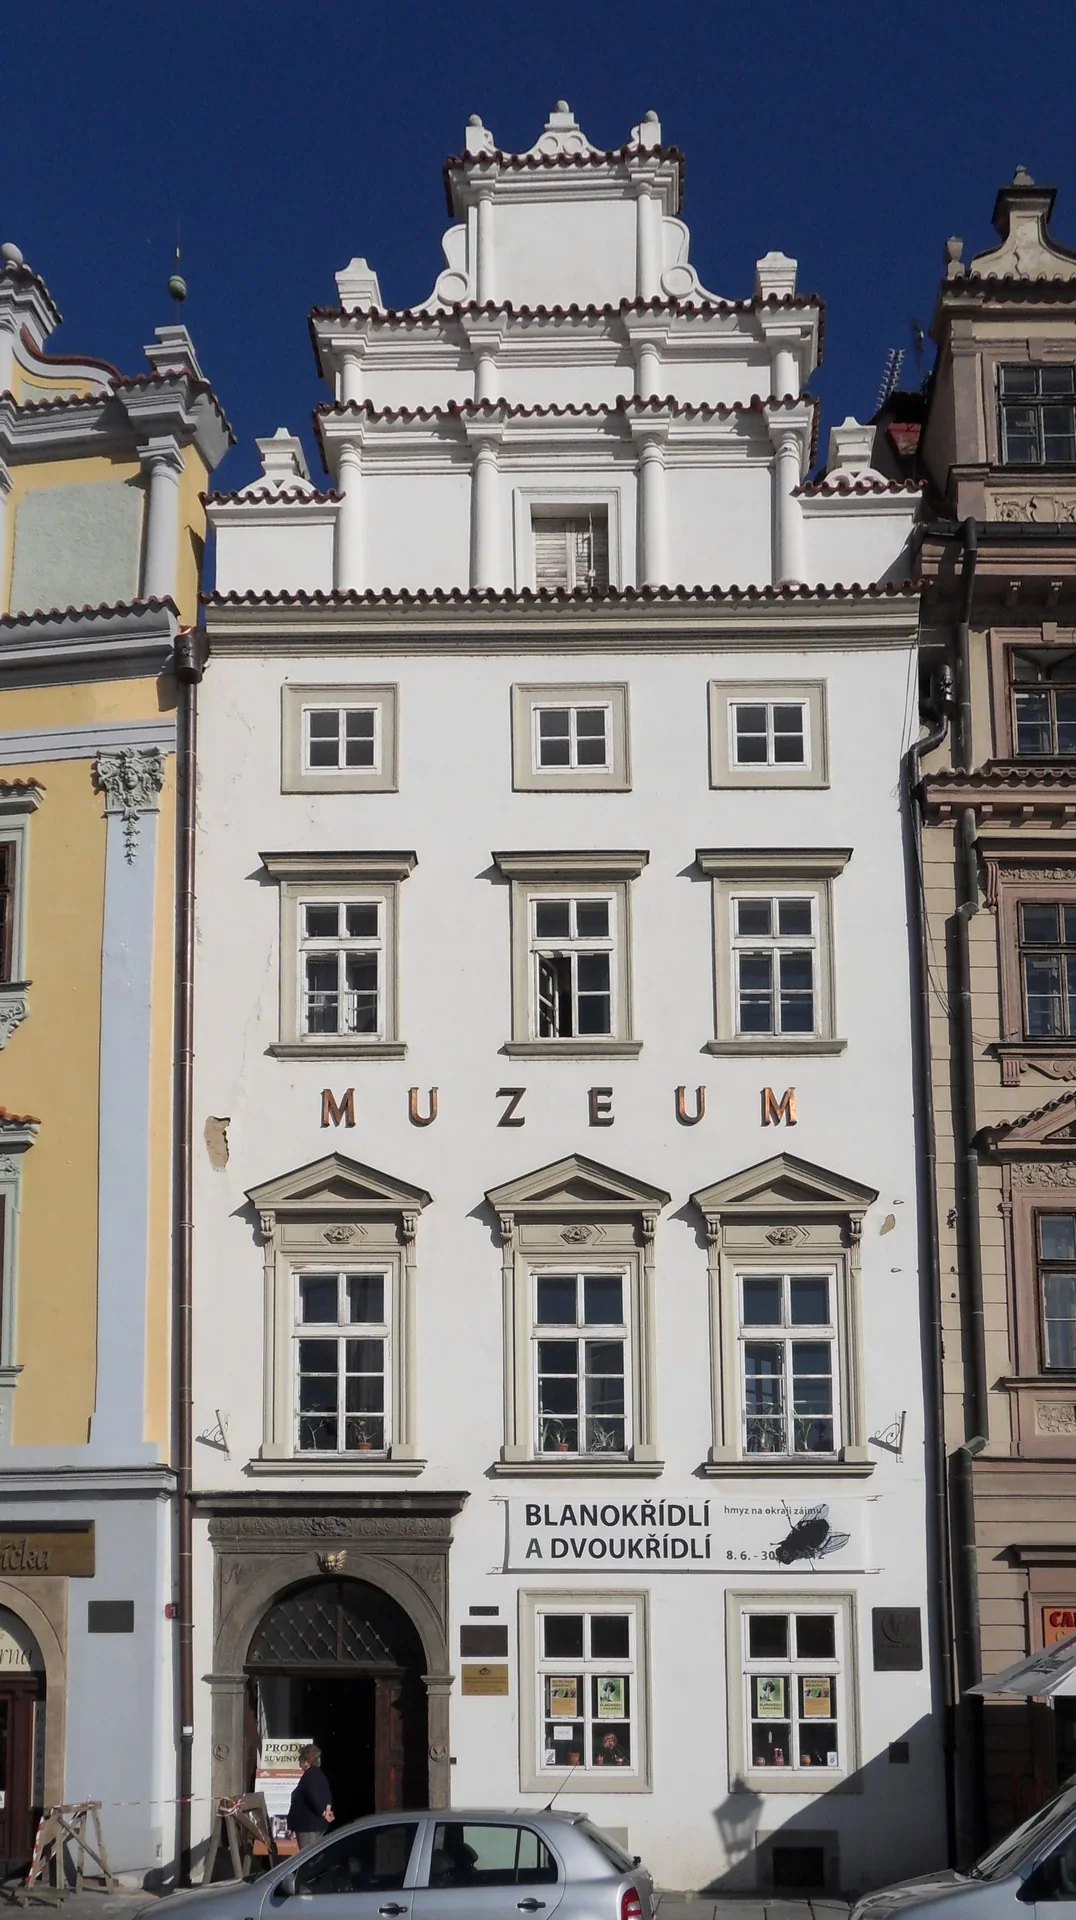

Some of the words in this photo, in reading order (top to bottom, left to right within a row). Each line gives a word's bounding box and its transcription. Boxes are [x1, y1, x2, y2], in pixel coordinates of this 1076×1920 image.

[320, 1085, 798, 1128] MUZEUM
[525, 1499, 711, 1527] BLANOKŘÍDLÍ
[724, 1505, 749, 1516] hmyz
[751, 1507, 762, 1515] na
[765, 1506, 791, 1516] okraji
[794, 1506, 822, 1516] zájmu
[525, 1538, 543, 1559] A
[551, 1533, 711, 1559] DVOUKŘÍDLÍ
[726, 1550, 737, 1560] 8.
[740, 1550, 751, 1561] 6.
[264, 1754, 300, 1763] SUVENÝ
